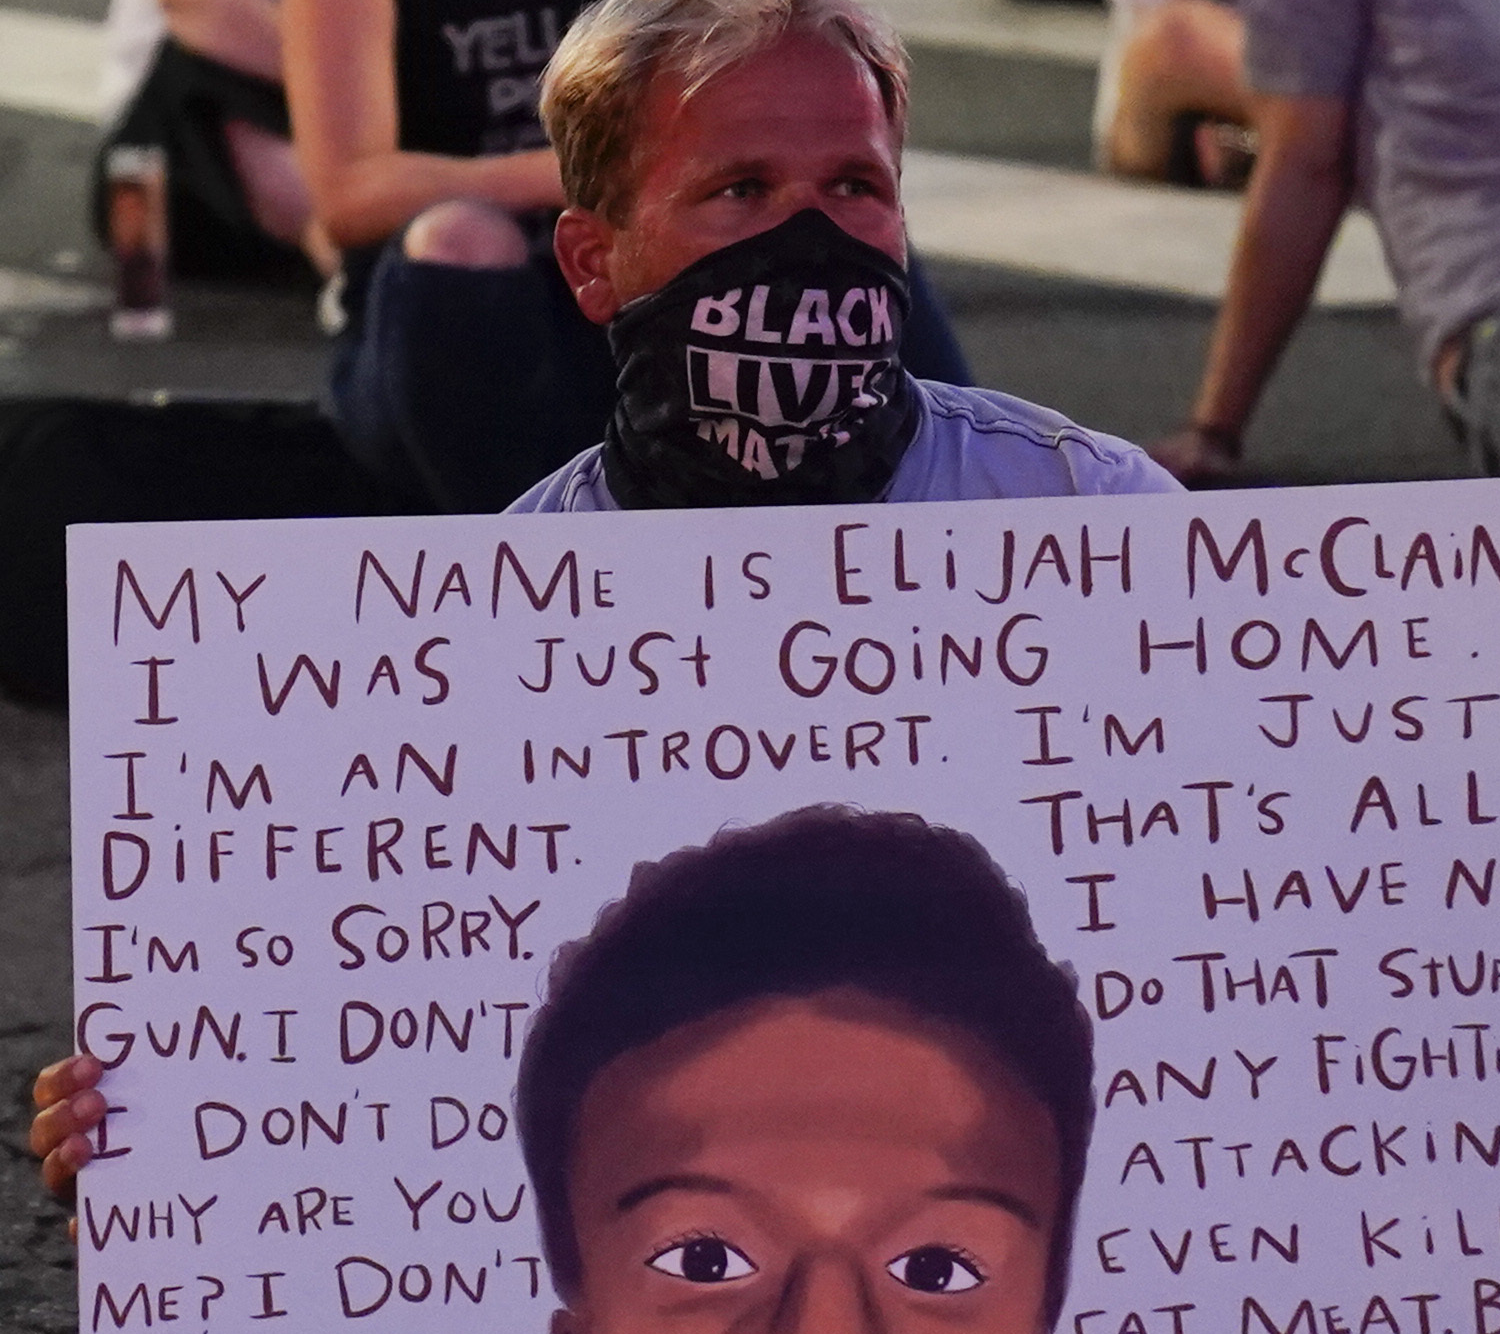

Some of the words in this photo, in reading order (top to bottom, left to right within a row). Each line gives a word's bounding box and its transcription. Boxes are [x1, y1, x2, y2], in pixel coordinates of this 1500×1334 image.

[690, 284, 892, 345] BLACK
[113, 559, 266, 646] MY
[355, 541, 615, 622] NAME
[704, 551, 771, 610] IS
[132, 656, 178, 725] I
[257, 636, 450, 716] WAS
[104, 752, 273, 821] I'M
[341, 742, 458, 797] AN
[1015, 706, 1165, 766] I'M
[1259, 693, 1500, 749] JUST
[1020, 781, 1291, 856] THAT'S
[85, 924, 199, 984] I'M
[236, 926, 294, 968] SO
[1065, 873, 1116, 933] I
[1202, 862, 1407, 923] HAVE
[264, 1010, 298, 1063] I
[340, 1000, 530, 1065] DON'T
[1095, 970, 1164, 1021] DO
[1172, 948, 1339, 1013] THAT
[194, 1090, 390, 1161] DON'T
[430, 1096, 508, 1151] DO
[1104, 1050, 1278, 1108] ANY
[84, 1194, 218, 1252] WHY
[258, 1187, 354, 1236] ARE
[393, 1177, 526, 1231] YOU
[248, 1272, 288, 1320] I
[335, 1249, 540, 1319] DON'T
[1097, 1223, 1299, 1275] EVEN
